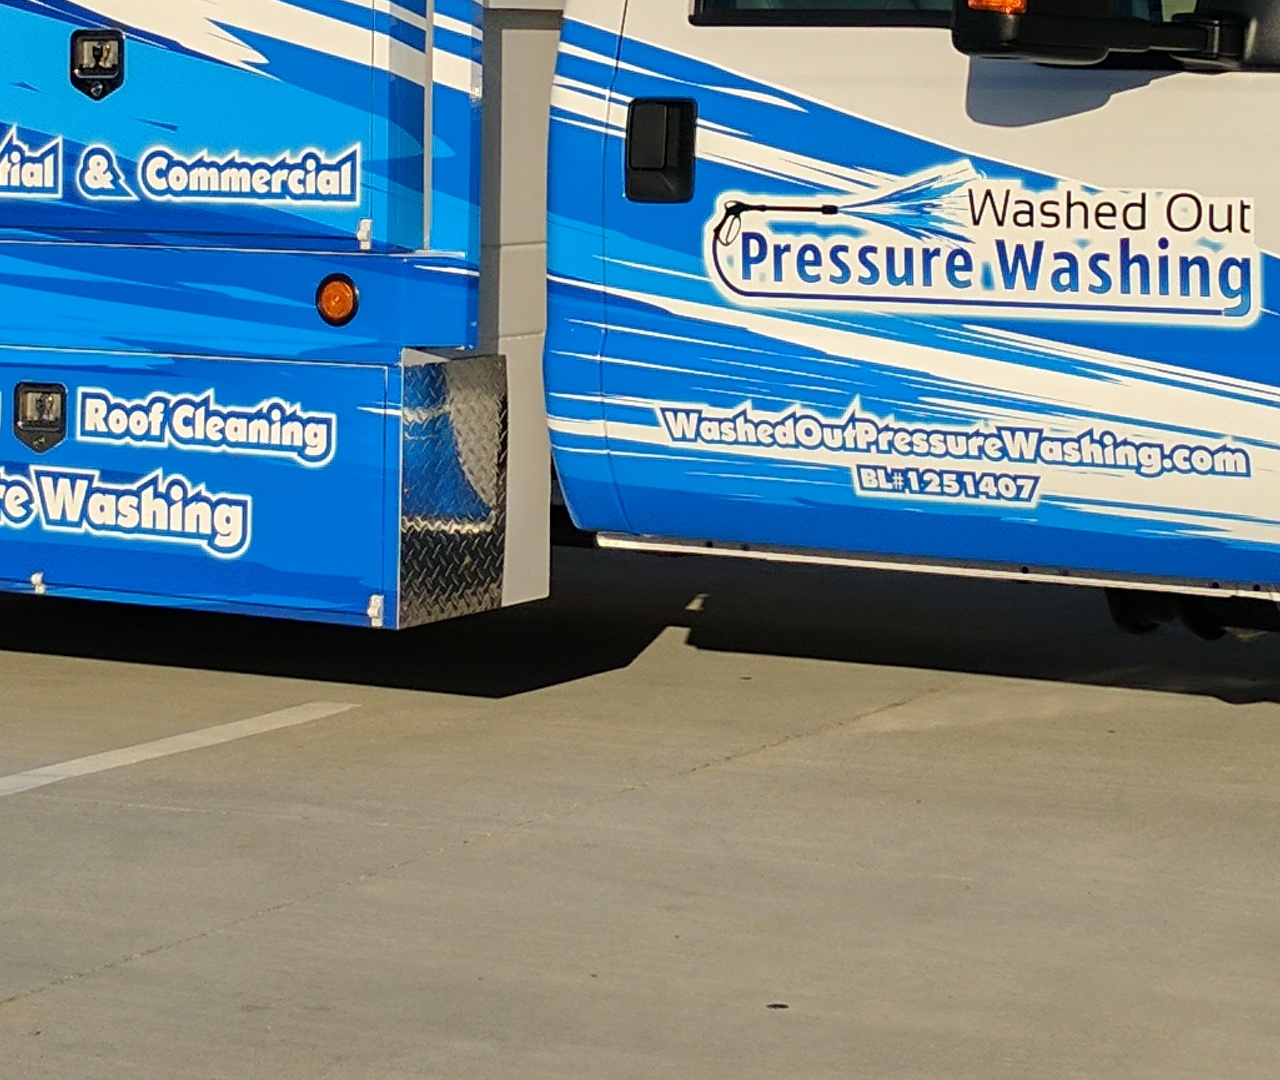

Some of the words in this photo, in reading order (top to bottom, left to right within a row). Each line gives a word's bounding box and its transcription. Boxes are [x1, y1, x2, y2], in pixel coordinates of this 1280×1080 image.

[81, 149, 120, 194] &
[142, 149, 358, 200] Commercial
[966, 187, 1147, 232] Washed
[1164, 192, 1252, 234] Out
[739, 230, 974, 288] Pressure
[994, 236, 1252, 317] Washing
[80, 394, 169, 440] Roof
[170, 399, 331, 460] Cleaning
[660, 407, 1252, 478] WashedOutPressureWashing.com
[33, 471, 247, 552] Washing
[856, 464, 1040, 503] BL#1251407
